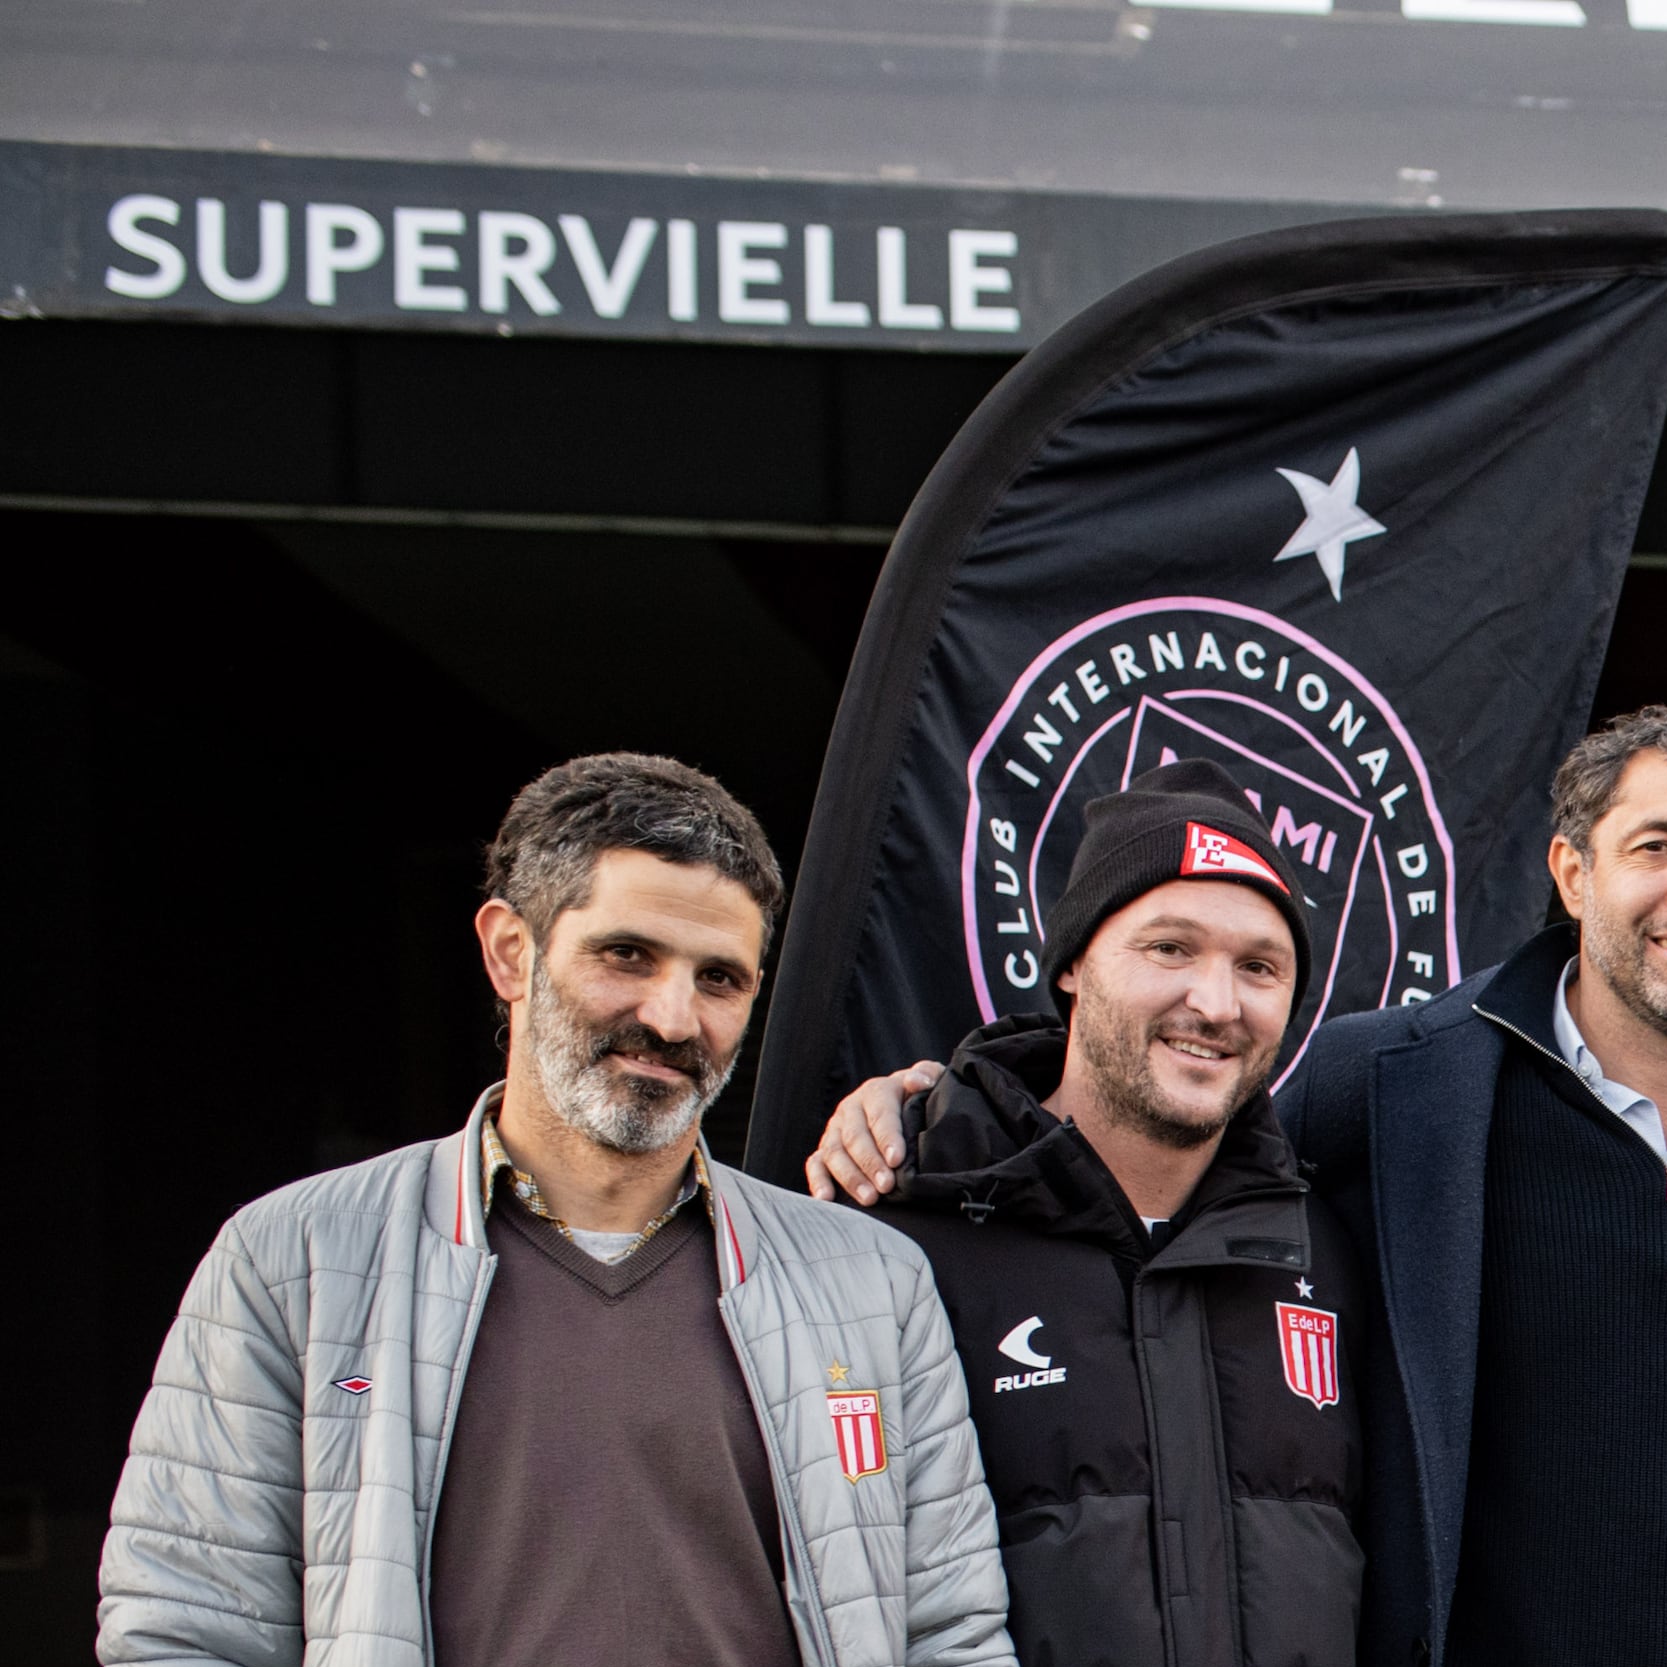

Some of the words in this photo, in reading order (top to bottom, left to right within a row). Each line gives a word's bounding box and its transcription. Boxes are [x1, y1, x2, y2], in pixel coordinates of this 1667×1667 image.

[104, 194, 1020, 332] SUPERVIELLE
[1005, 631, 1408, 819] INTERNACIONAL
[990, 818, 1040, 990] CLUB
[1397, 843, 1437, 918] DE
[994, 1367, 1067, 1393] RUGE
